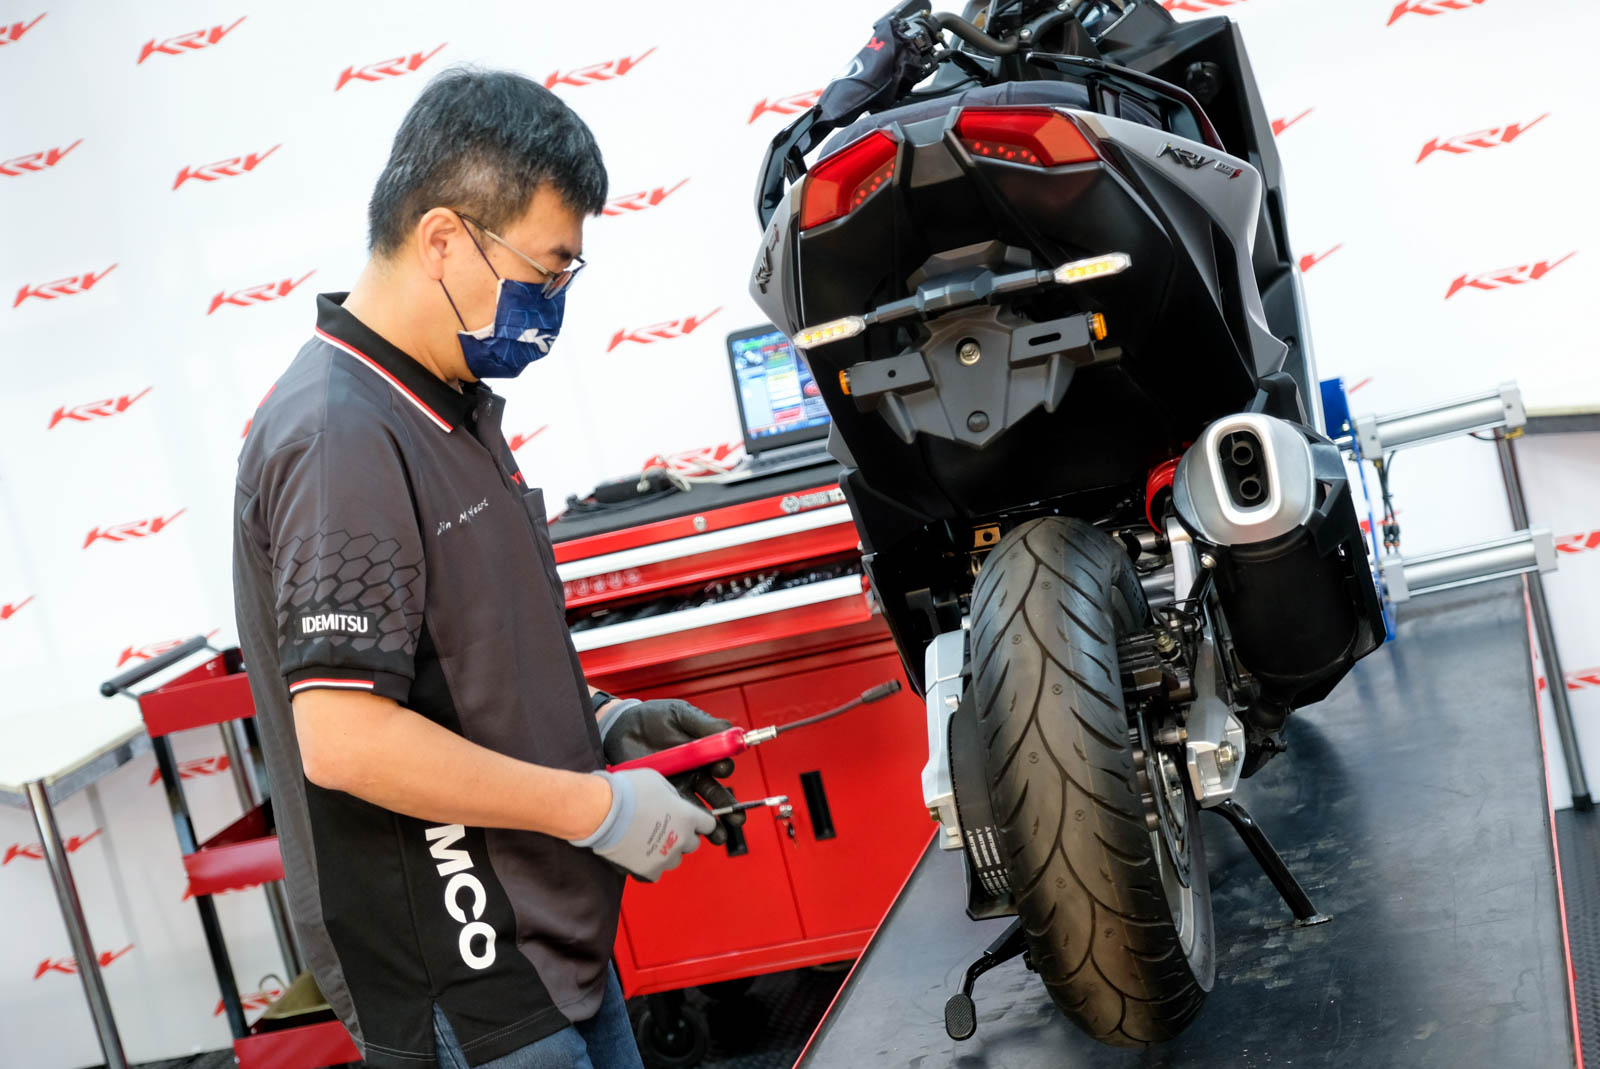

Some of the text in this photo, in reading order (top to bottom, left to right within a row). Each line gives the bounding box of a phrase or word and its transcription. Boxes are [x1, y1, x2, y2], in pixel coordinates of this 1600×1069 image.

[137, 16, 246, 64] KRV
[335, 44, 445, 91] KRV
[544, 48, 656, 90] KRV
[748, 89, 824, 125] KR
[1416, 114, 1548, 164] KRV
[172, 144, 280, 191] KRV
[602, 178, 688, 216] RV
[13, 264, 117, 309] KRV
[208, 272, 315, 315] KRV
[1444, 252, 1575, 300] KRV
[606, 308, 720, 352] KRV
[48, 388, 150, 430] KRV
[83, 510, 184, 550] KRV
[301, 613, 368, 633] IDEMITSU
[2, 827, 104, 867] KV
[33, 943, 135, 980] KV
